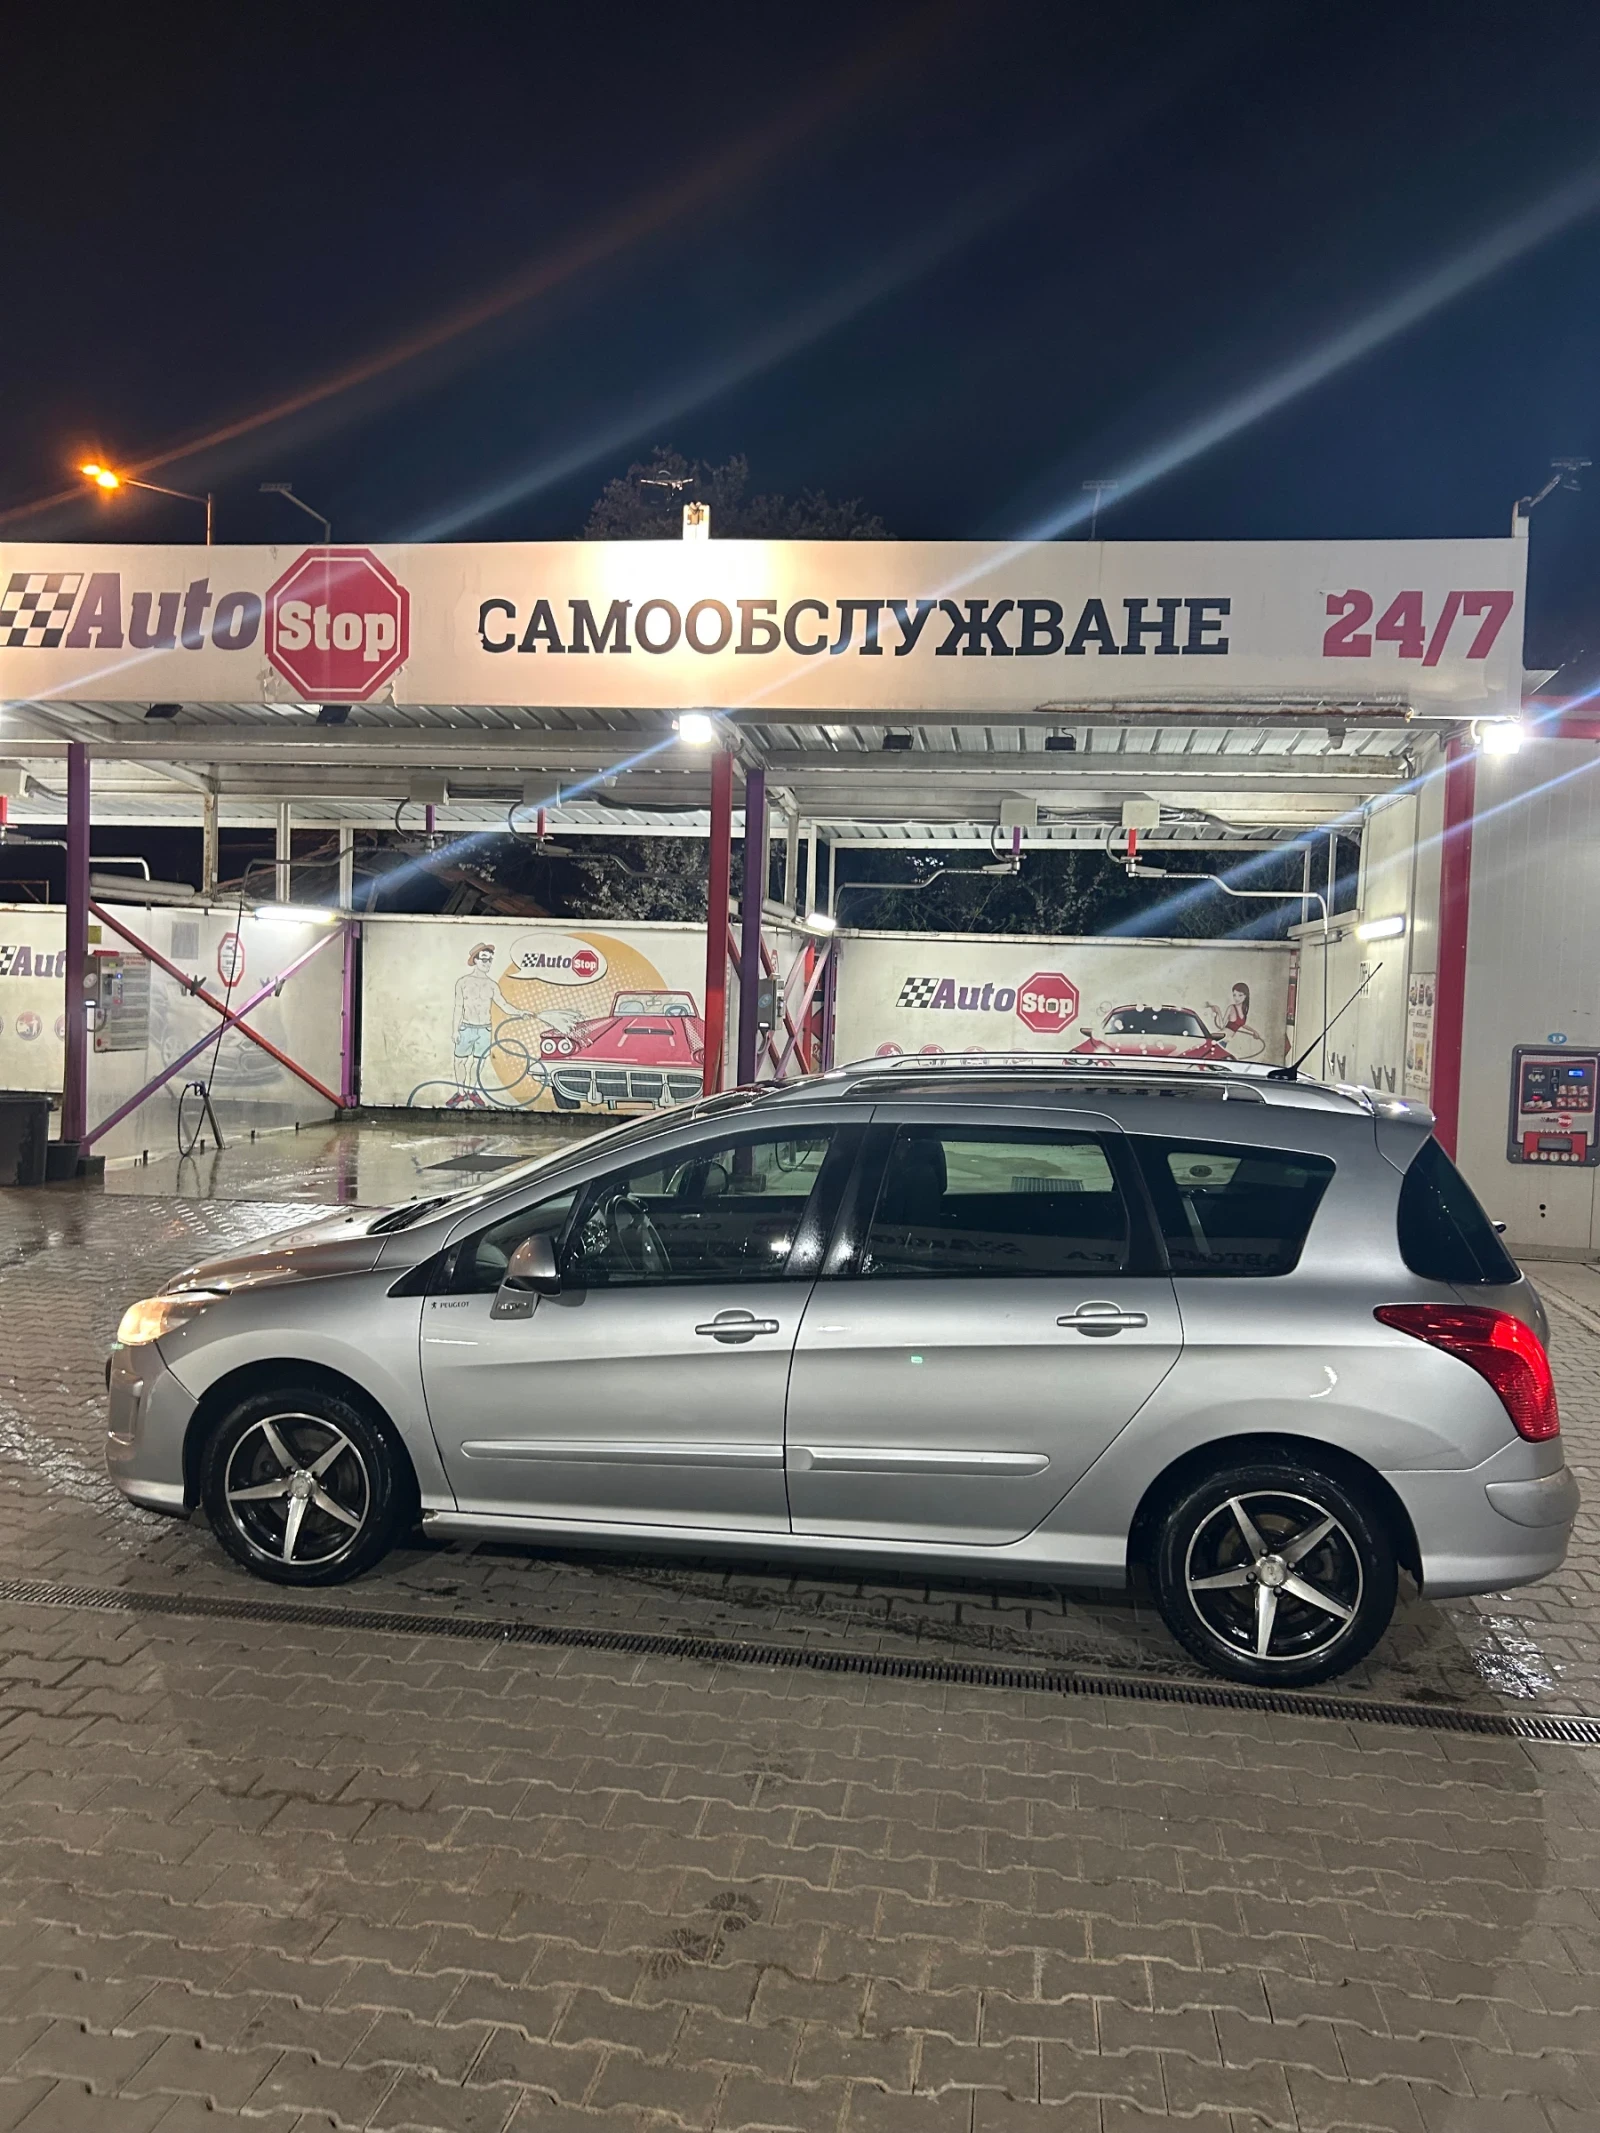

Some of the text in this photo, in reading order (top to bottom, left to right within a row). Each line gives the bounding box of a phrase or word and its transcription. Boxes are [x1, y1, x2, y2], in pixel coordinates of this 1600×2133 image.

[66, 572, 396, 663] Auto Stop
[477, 597, 1231, 656] САМООБСЛУЖВАНЕ
[1322, 588, 1514, 667] 24/7
[9, 945, 67, 978] Aut
[535, 953, 597, 971] Auto Stop
[930, 978, 1074, 1019] Auto Stop
[440, 1301, 469, 1309] PEUGEOT
